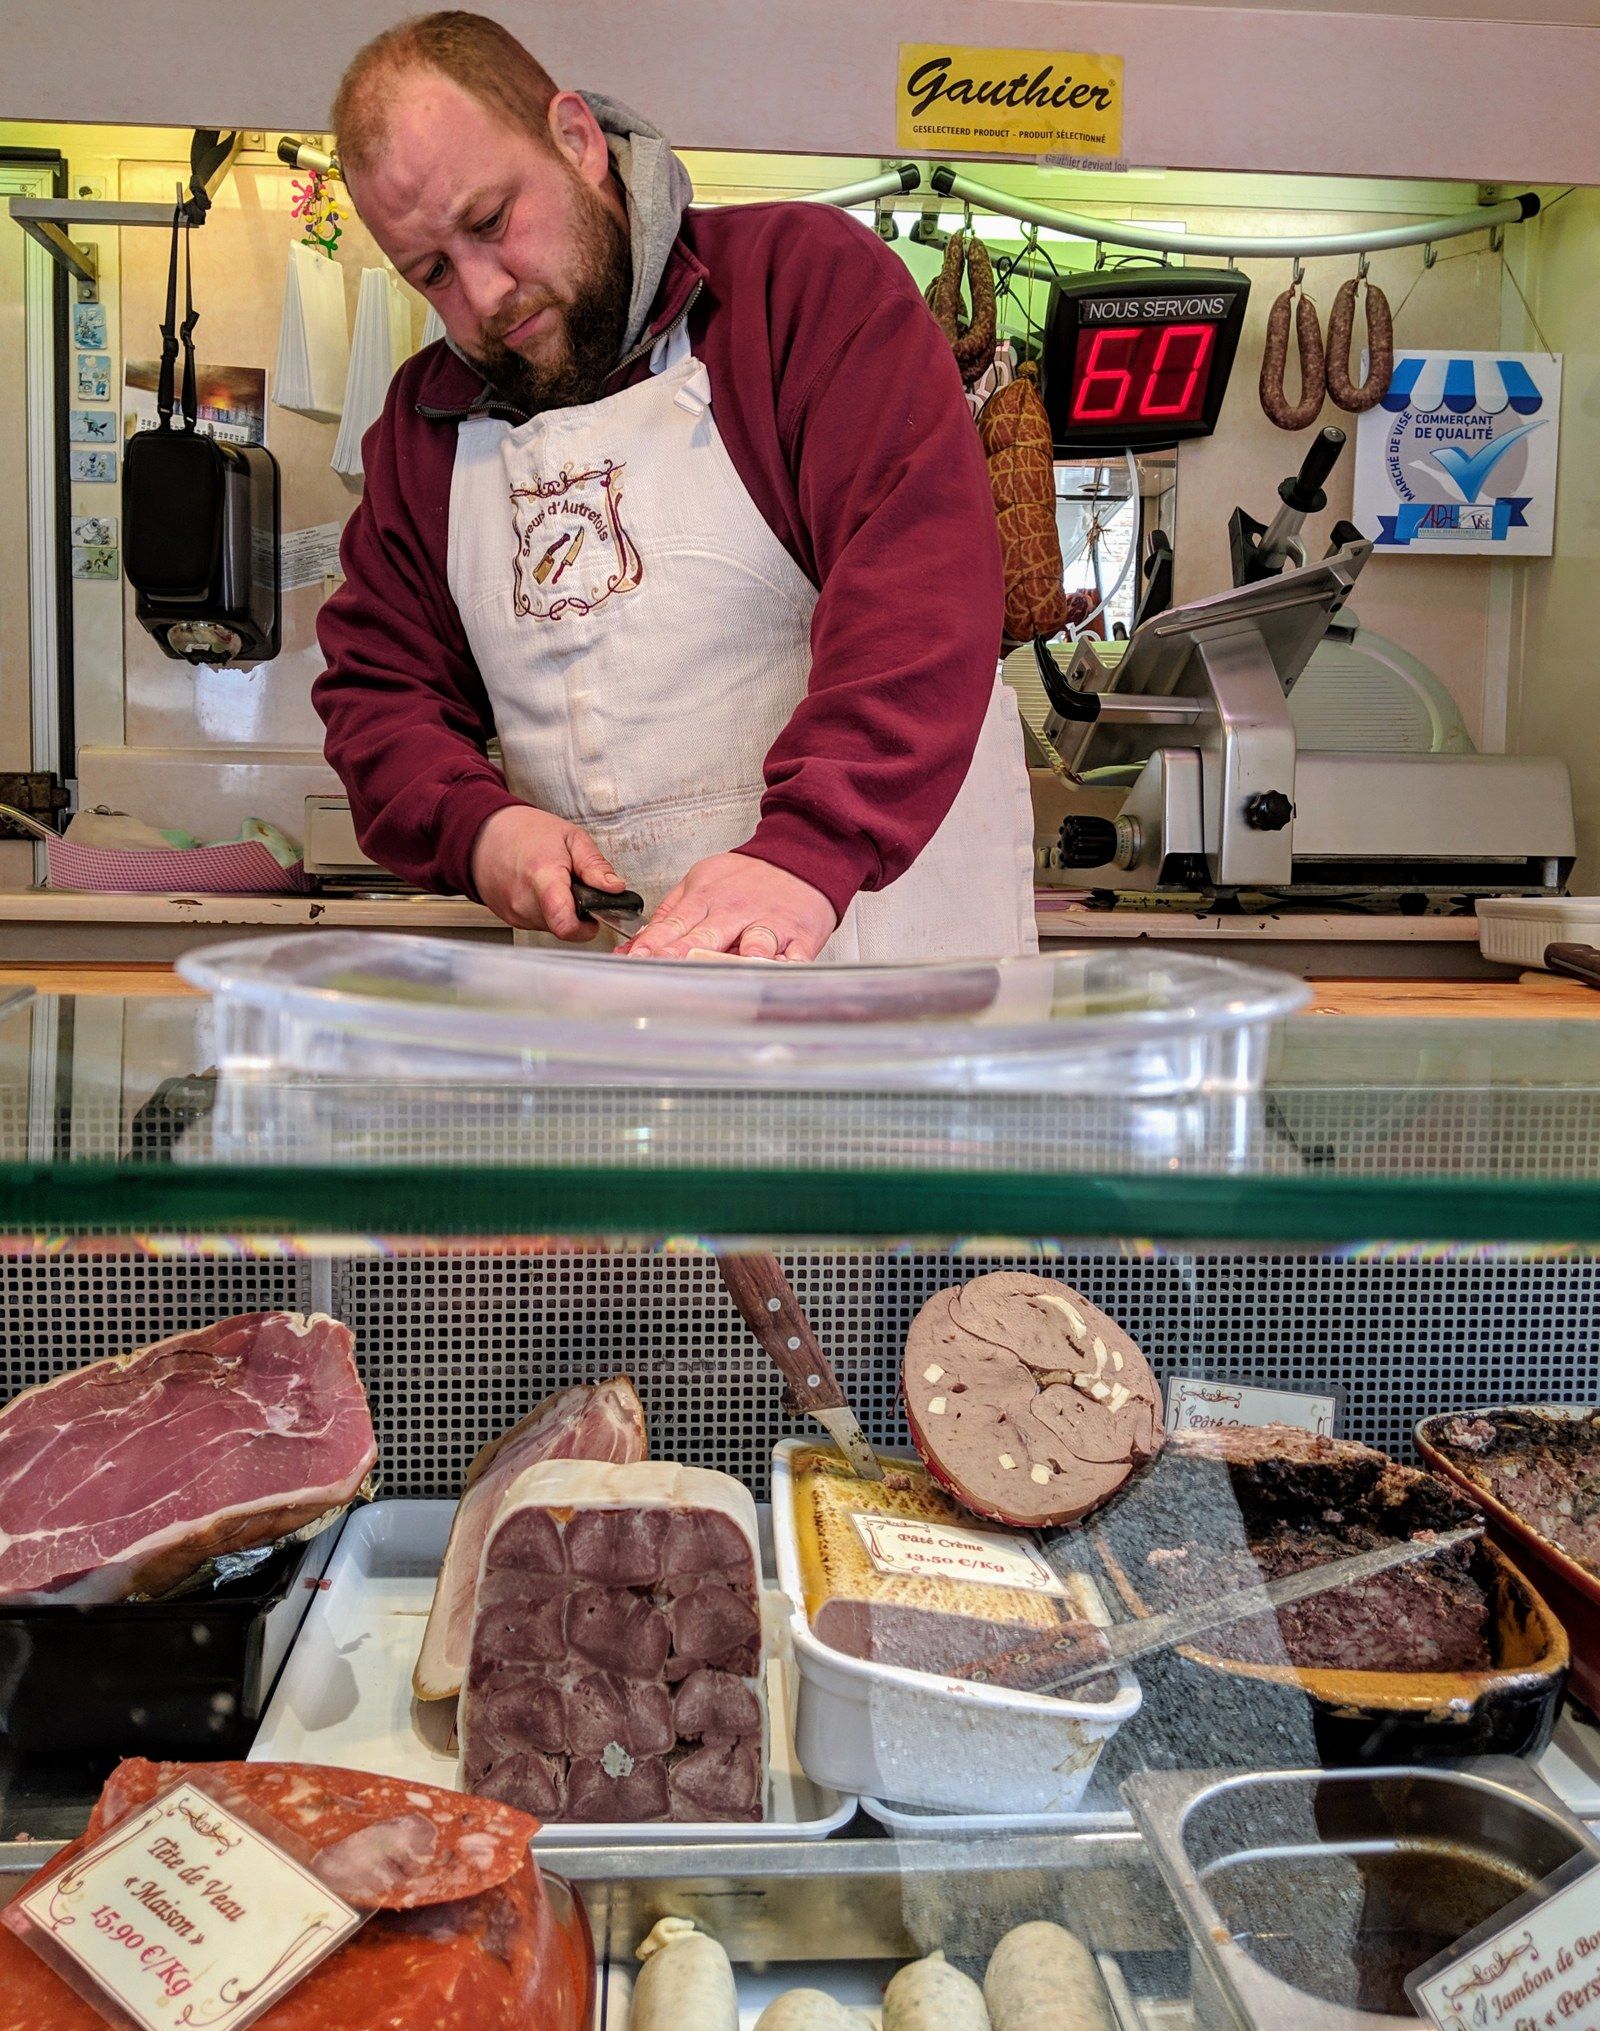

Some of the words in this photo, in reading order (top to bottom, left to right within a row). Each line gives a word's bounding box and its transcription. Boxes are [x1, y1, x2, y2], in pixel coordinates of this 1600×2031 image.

[907, 57, 1112, 117] Gauthier
[913, 125, 971, 136] GESELECTEERD
[974, 128, 1010, 138] PRODUCT
[1019, 131, 1053, 139] PRODUIT
[1056, 131, 1106, 143] SÉLECTIONNÉ
[1089, 302, 1139, 319] NOUS
[1142, 298, 1225, 317] SERVONS
[1073, 326, 1214, 419] 60
[1414, 427, 1432, 439] DE
[1435, 426, 1494, 441] QUALITÉ
[1415, 414, 1494, 427] COMMERÇANT
[1389, 438, 1400, 453] DE
[1387, 456, 1416, 501] MARCHÉ
[898, 1533, 934, 1545] Pâté
[938, 1538, 984, 1552] Crème
[147, 1836, 187, 1870] Tête
[177, 1864, 210, 1889] de
[200, 1879, 247, 1922] Veau
[91, 1904, 144, 1950] 15,90
[1491, 1966, 1554, 2020] Jambon
[1556, 1946, 1574, 1974] de
